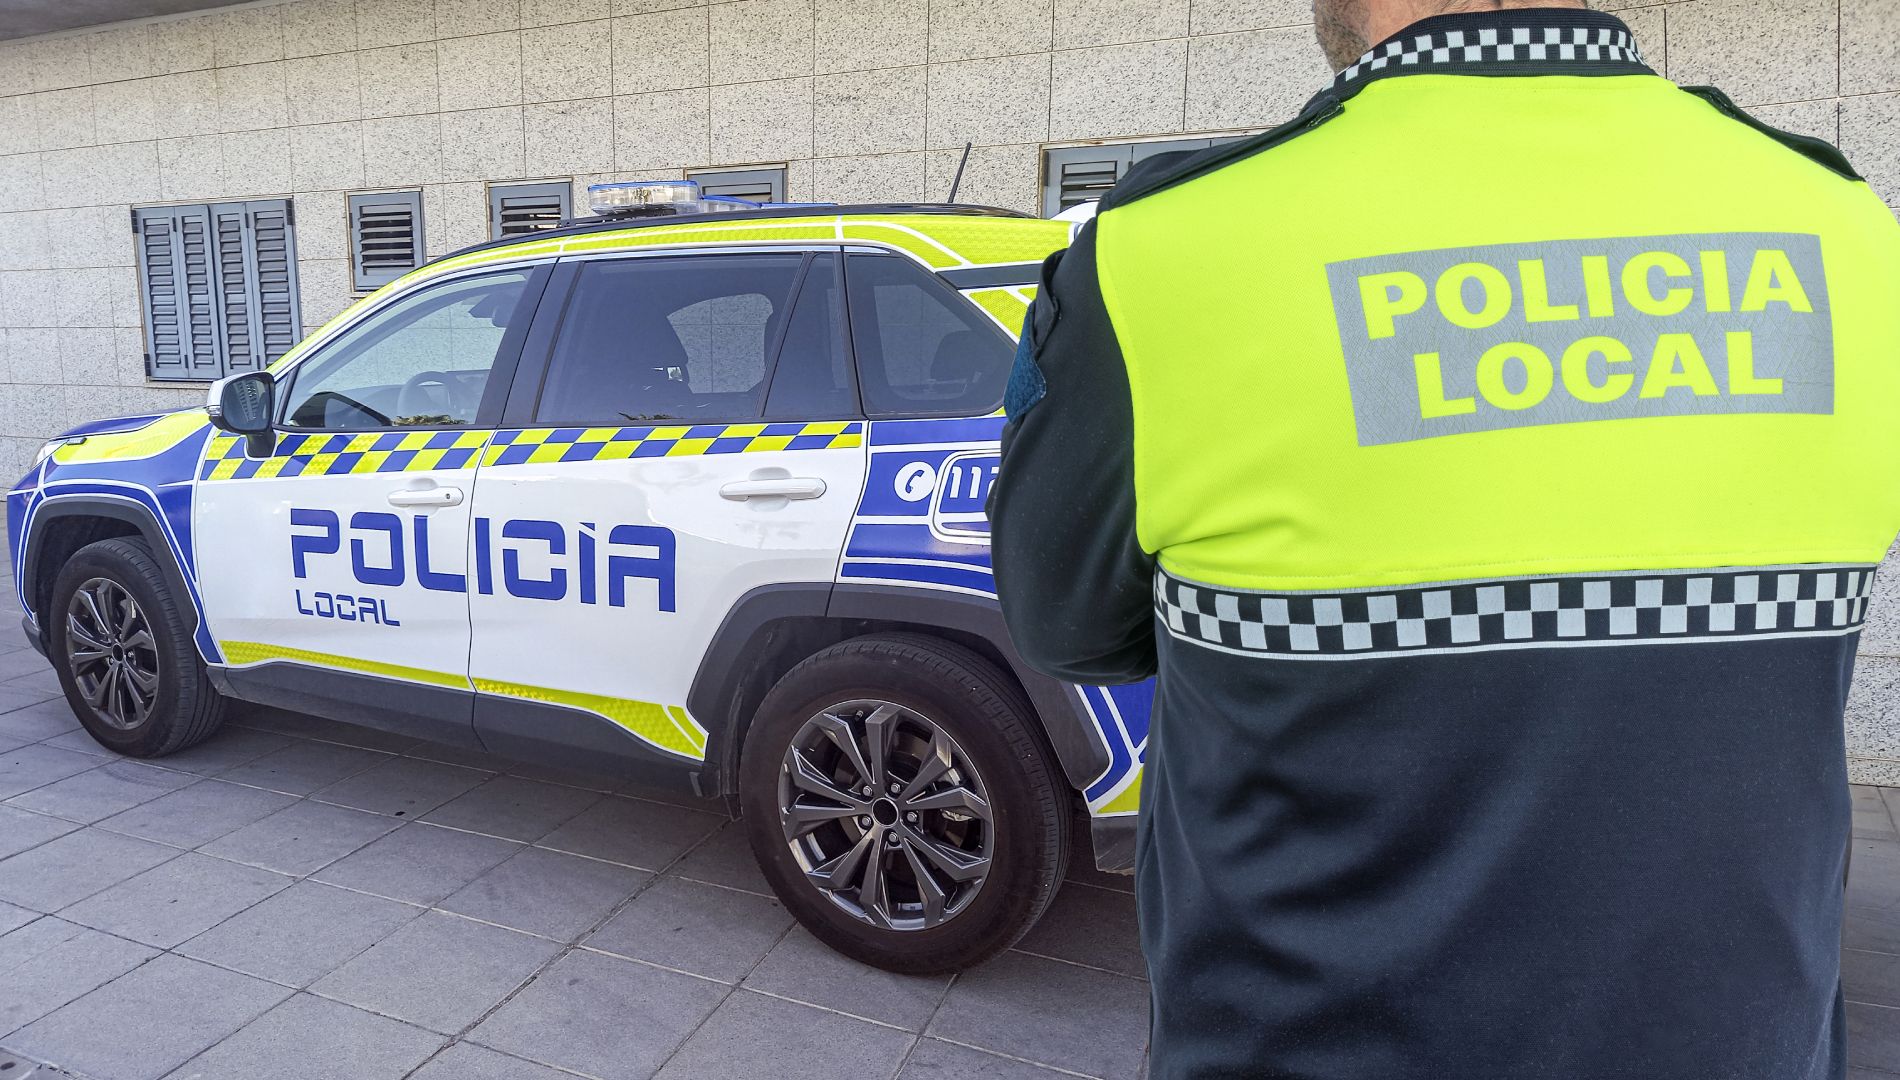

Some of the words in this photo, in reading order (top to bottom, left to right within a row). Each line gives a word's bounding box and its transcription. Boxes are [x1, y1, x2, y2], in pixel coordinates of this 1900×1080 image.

[1358, 249, 1814, 340] POLICIA
[1413, 331, 1784, 419] LOCAL
[295, 588, 401, 627] LOCAL
